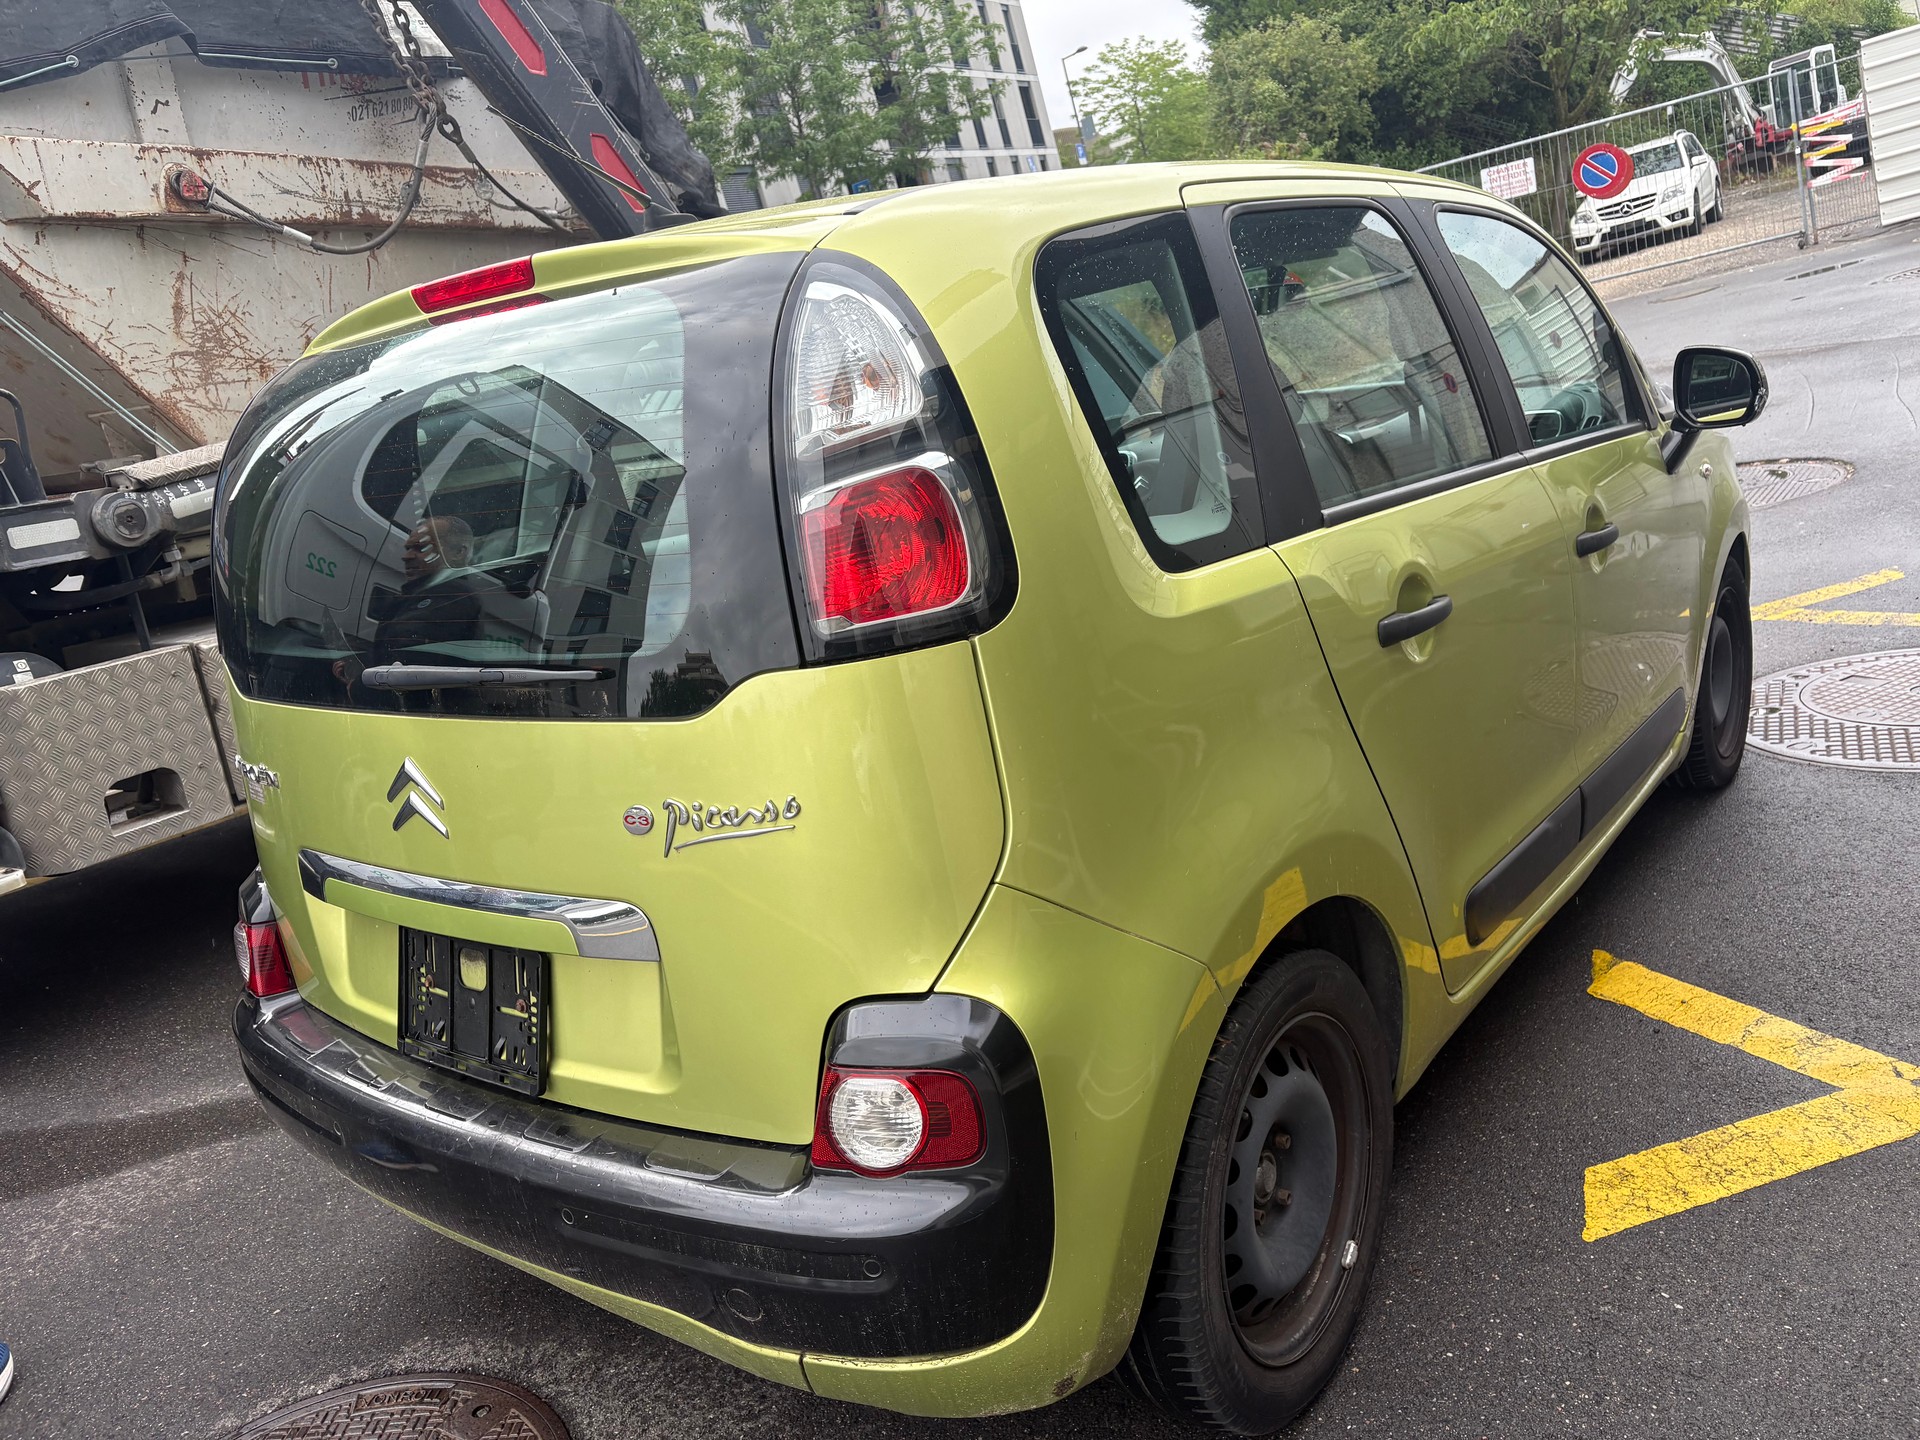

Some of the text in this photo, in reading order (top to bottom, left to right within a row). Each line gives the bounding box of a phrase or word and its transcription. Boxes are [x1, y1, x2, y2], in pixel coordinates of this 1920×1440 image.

[351, 102, 370, 122] 021
[372, 100, 389, 118] 621
[391, 98, 401, 114] 80
[1486, 161, 1529, 177] CHANTIER
[623, 795, 801, 858] C3 Picasso
